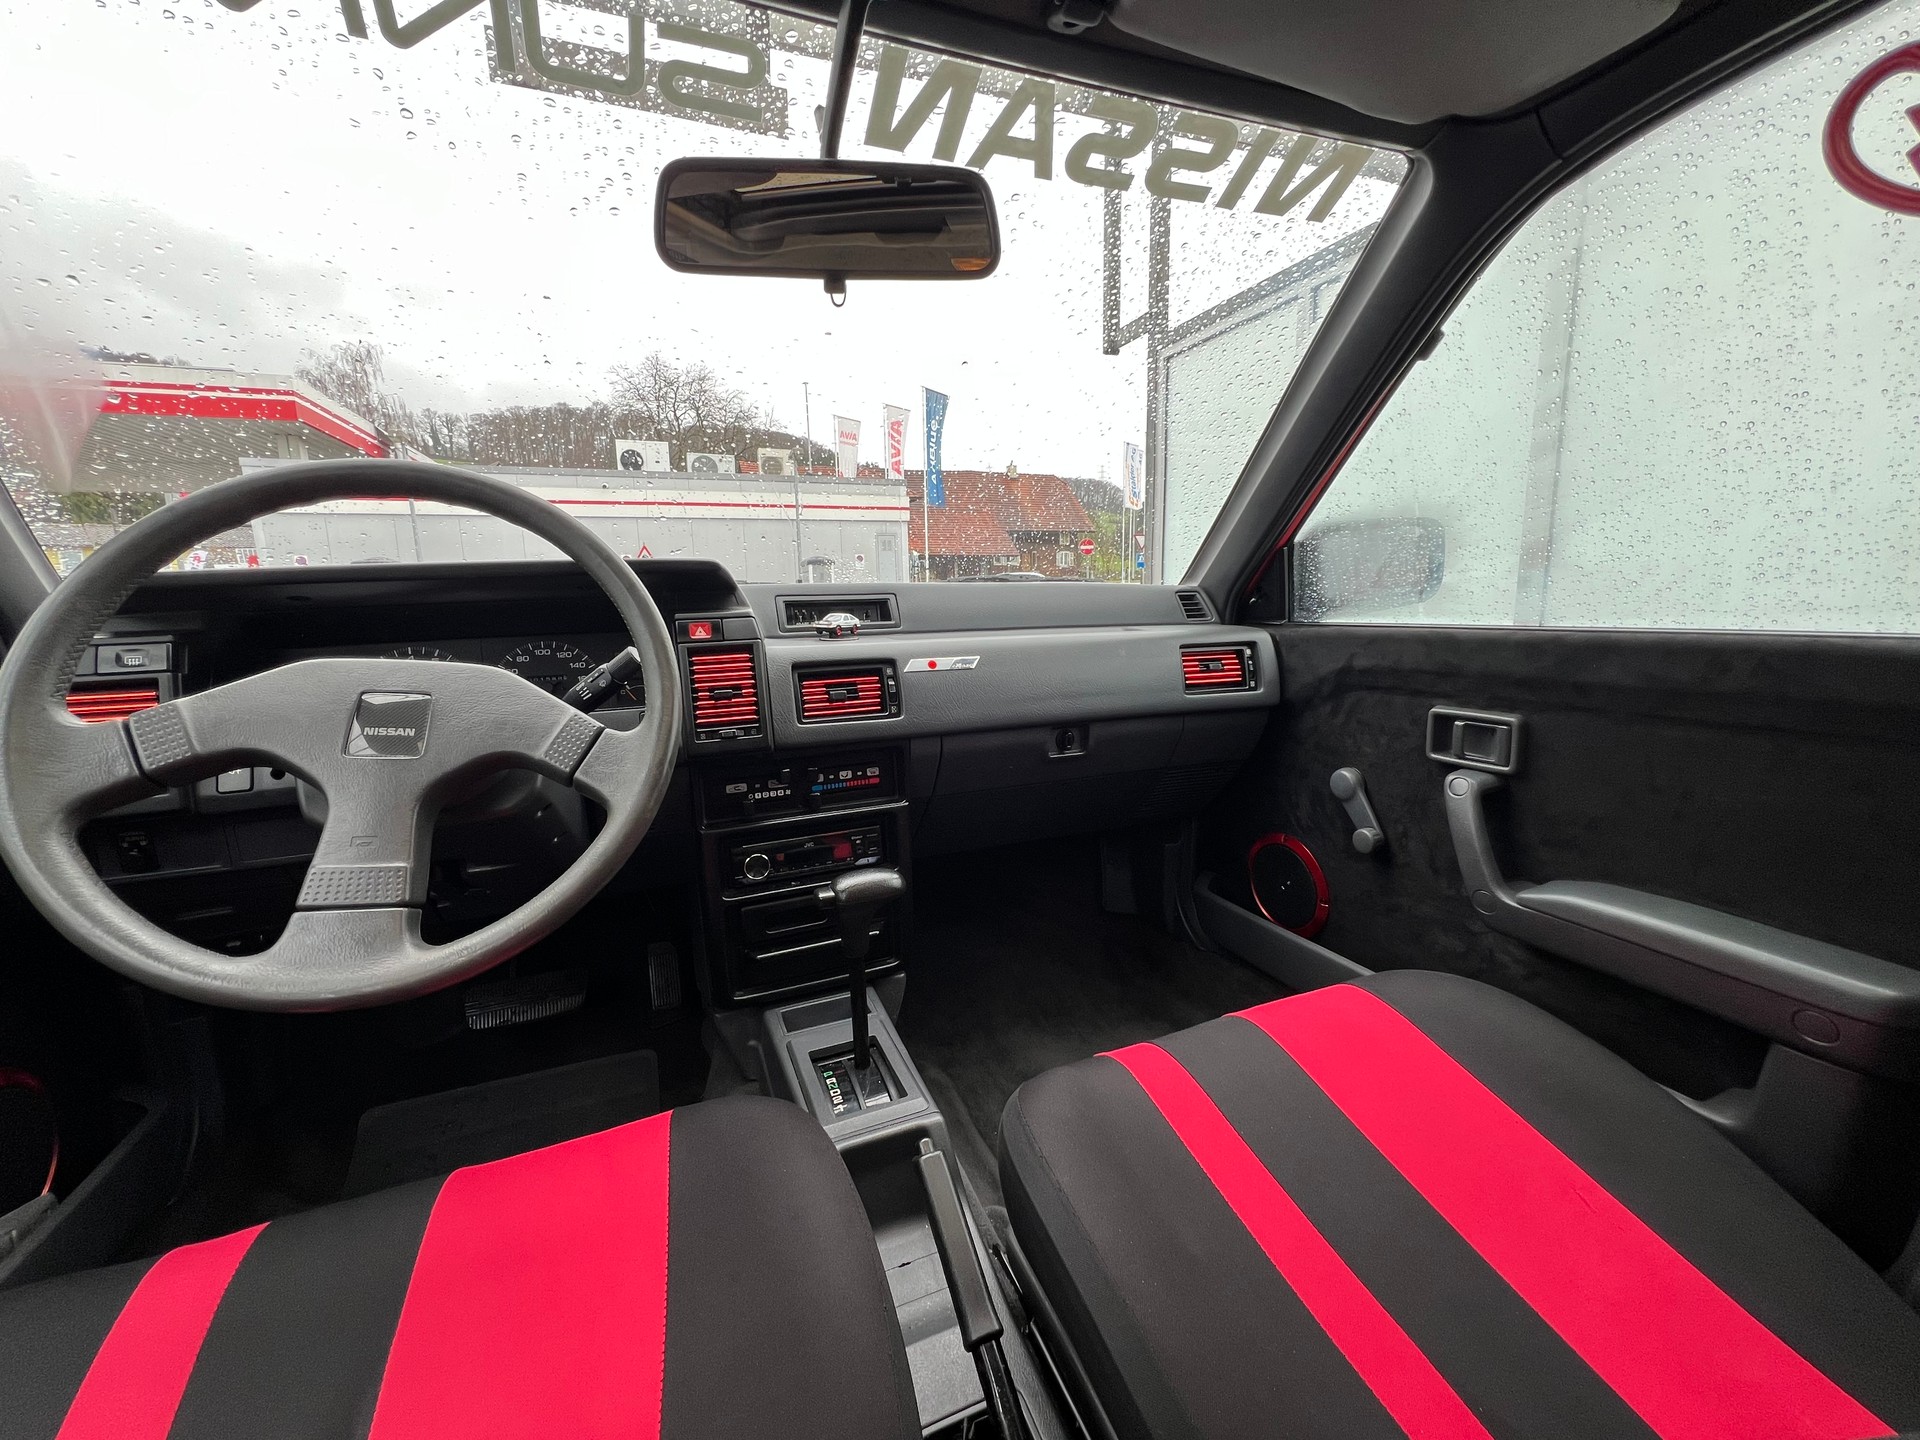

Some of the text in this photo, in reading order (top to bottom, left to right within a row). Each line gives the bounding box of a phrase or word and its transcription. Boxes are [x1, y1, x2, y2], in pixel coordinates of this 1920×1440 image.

[839, 430, 857, 441] AVIA
[889, 419, 903, 476] AVIA
[556, 651, 573, 659] 120
[569, 661, 586, 669] 140
[363, 722, 416, 737] NISSAN
